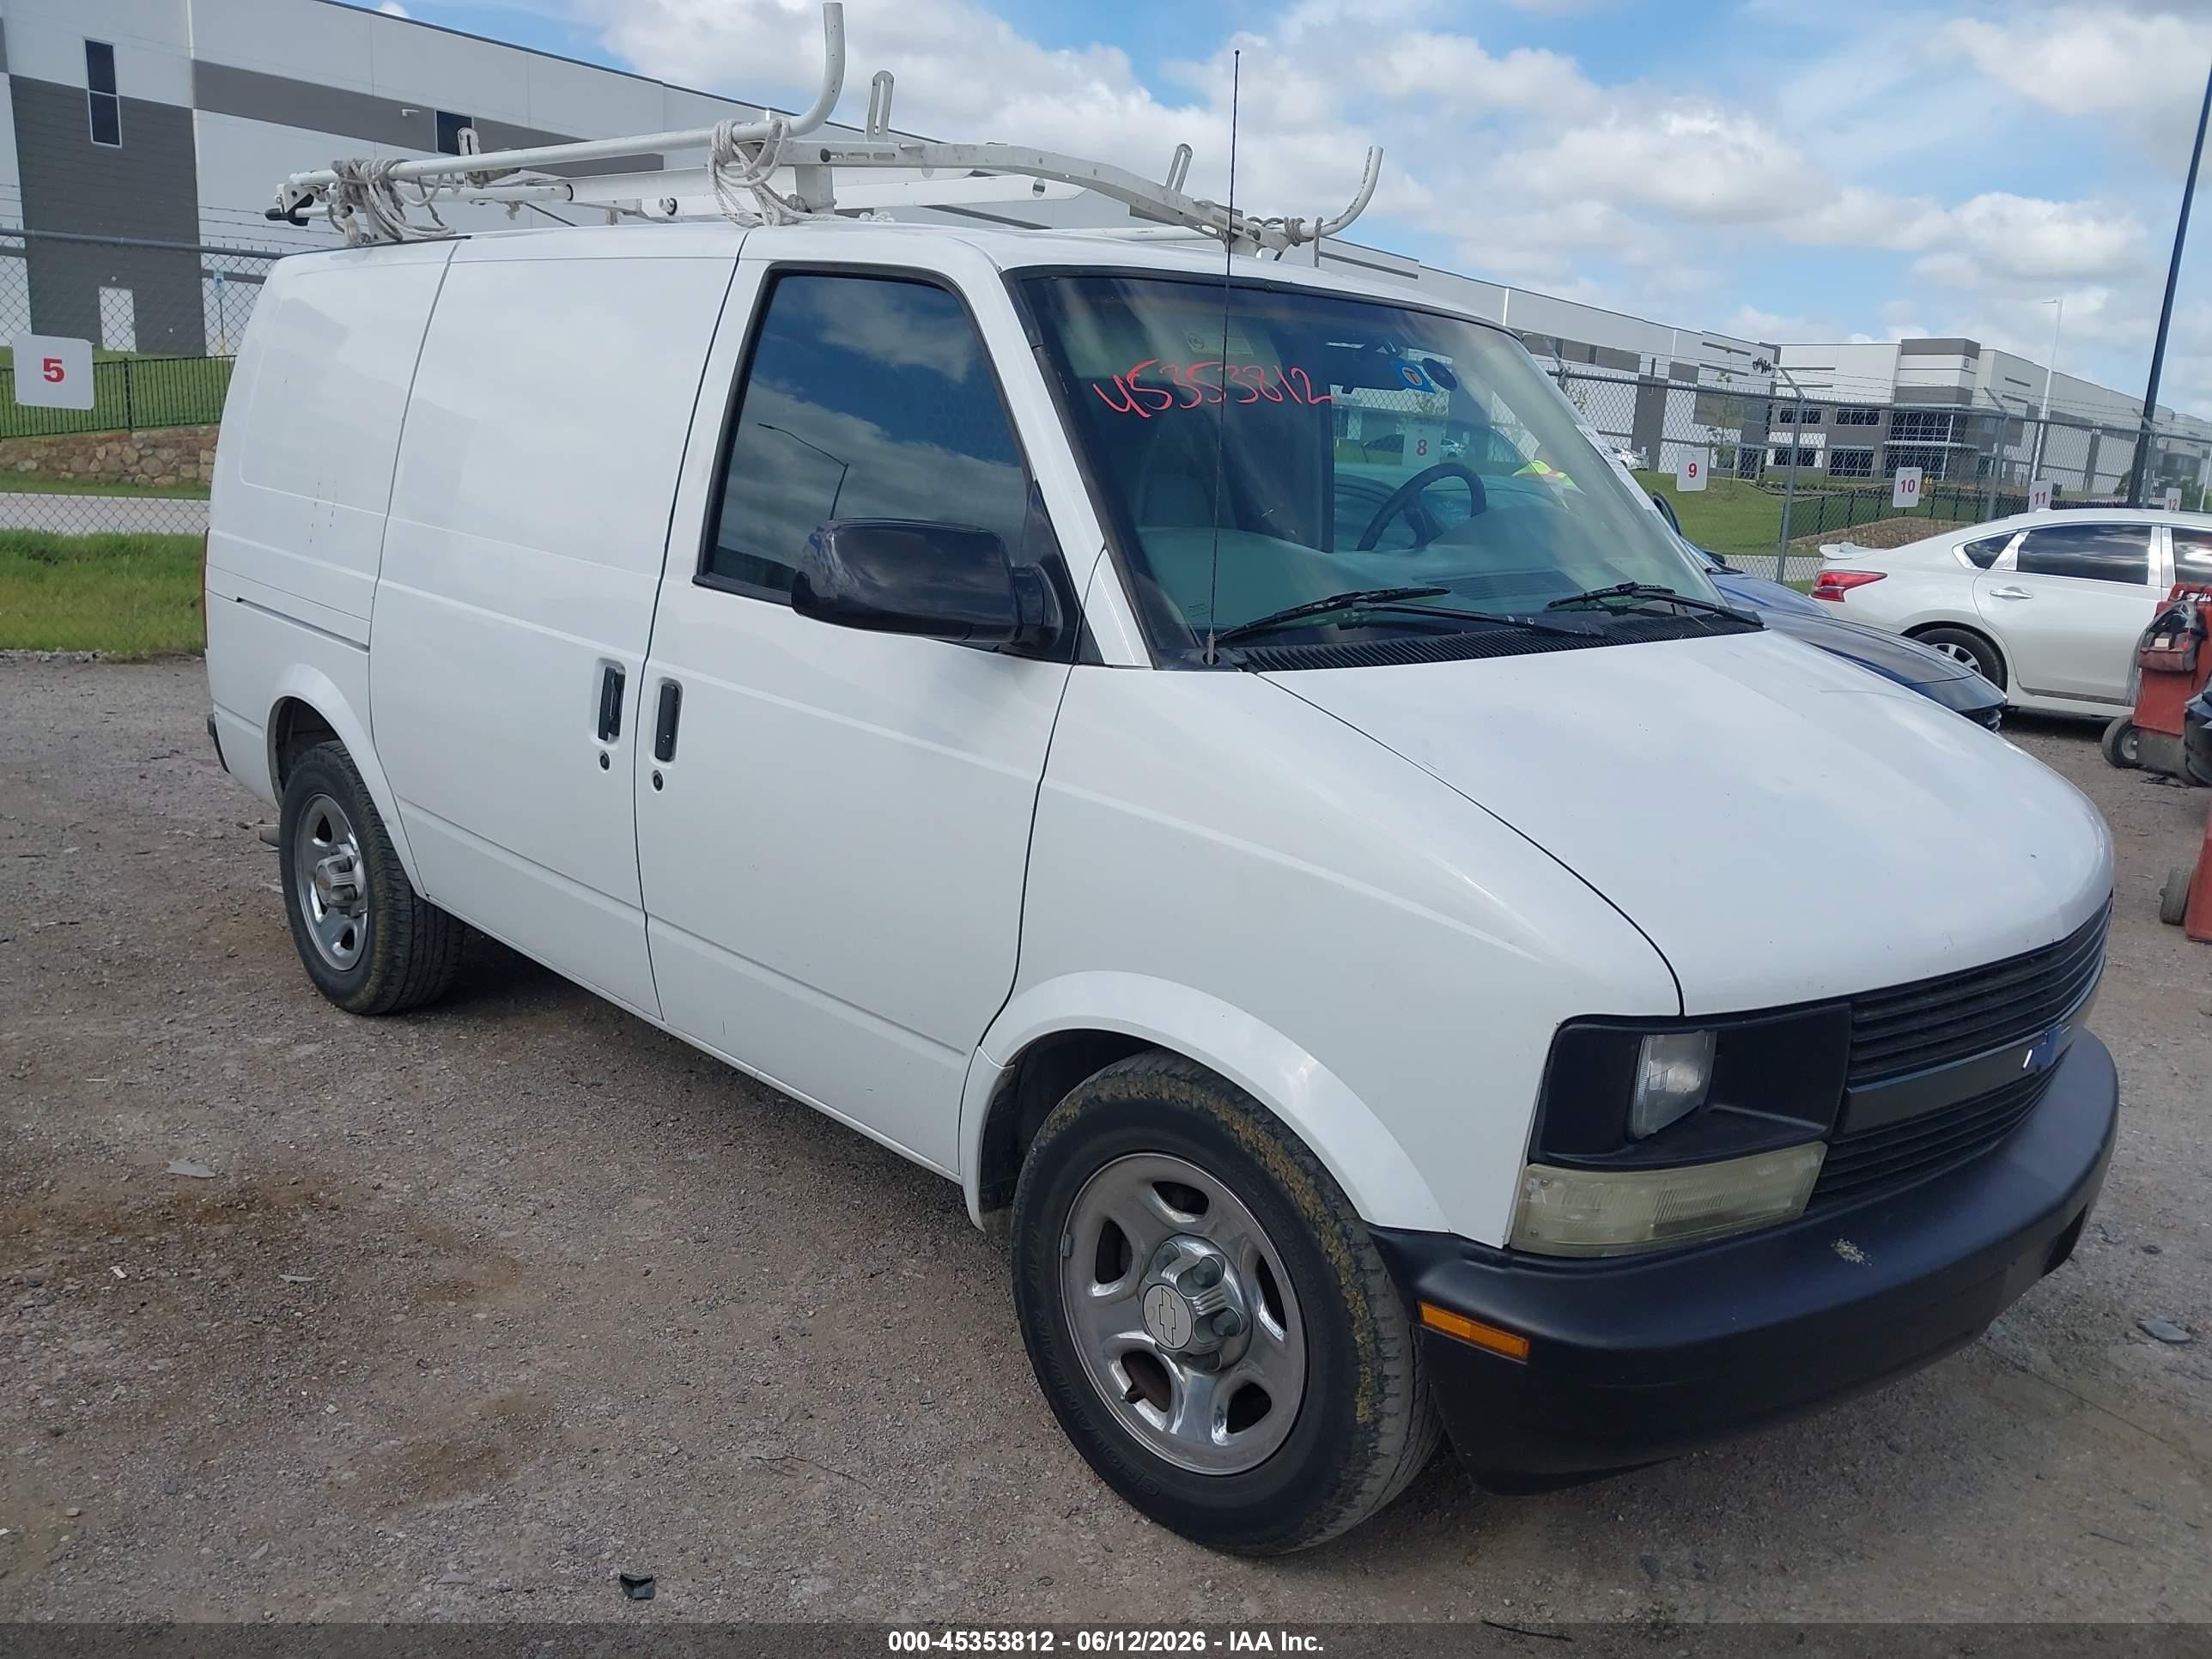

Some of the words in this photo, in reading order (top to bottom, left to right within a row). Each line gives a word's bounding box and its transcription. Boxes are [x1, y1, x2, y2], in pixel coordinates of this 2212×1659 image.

[43, 357, 65, 383] 5
[1416, 439, 1428, 457] 8
[1688, 462, 1698, 478] 9
[1900, 478, 1916, 494] 10
[2034, 491, 2047, 505] 11
